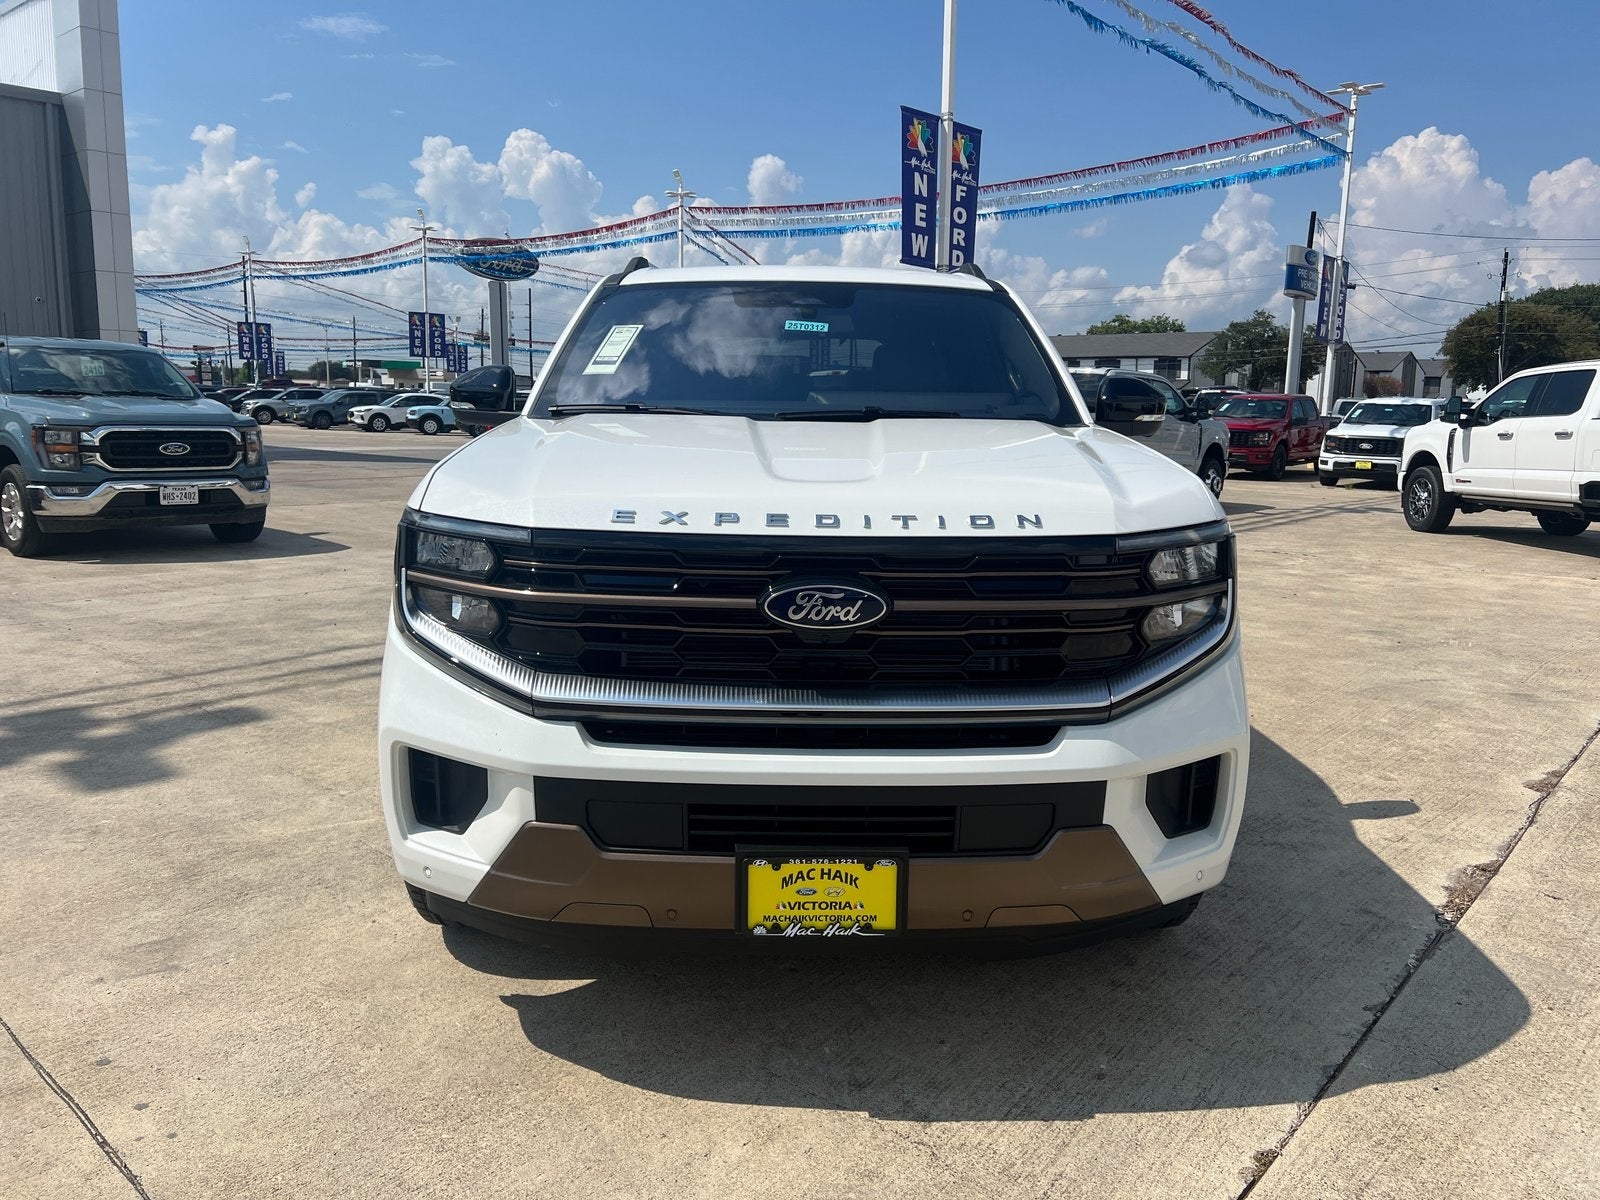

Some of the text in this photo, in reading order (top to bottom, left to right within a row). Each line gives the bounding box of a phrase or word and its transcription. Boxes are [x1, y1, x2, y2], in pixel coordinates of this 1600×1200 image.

[911, 171, 929, 258] NEW
[951, 184, 968, 267] FORD
[1297, 268, 1308, 279] PRE
[788, 321, 827, 332] 25T0312
[1335, 293, 1345, 341] FORD
[242, 336, 251, 358] NEW
[261, 337, 269, 359] FORD
[413, 329, 423, 356] NEW
[433, 331, 442, 357] FORD
[611, 508, 1043, 530] EXPEDITION
[787, 590, 863, 622] Ford
[781, 867, 860, 890] MAC HAIK
[787, 901, 853, 911] VICTORIA
[762, 914, 878, 923] MACHAIKVICTORIA.COM
[782, 922, 864, 938] Mac Haik
